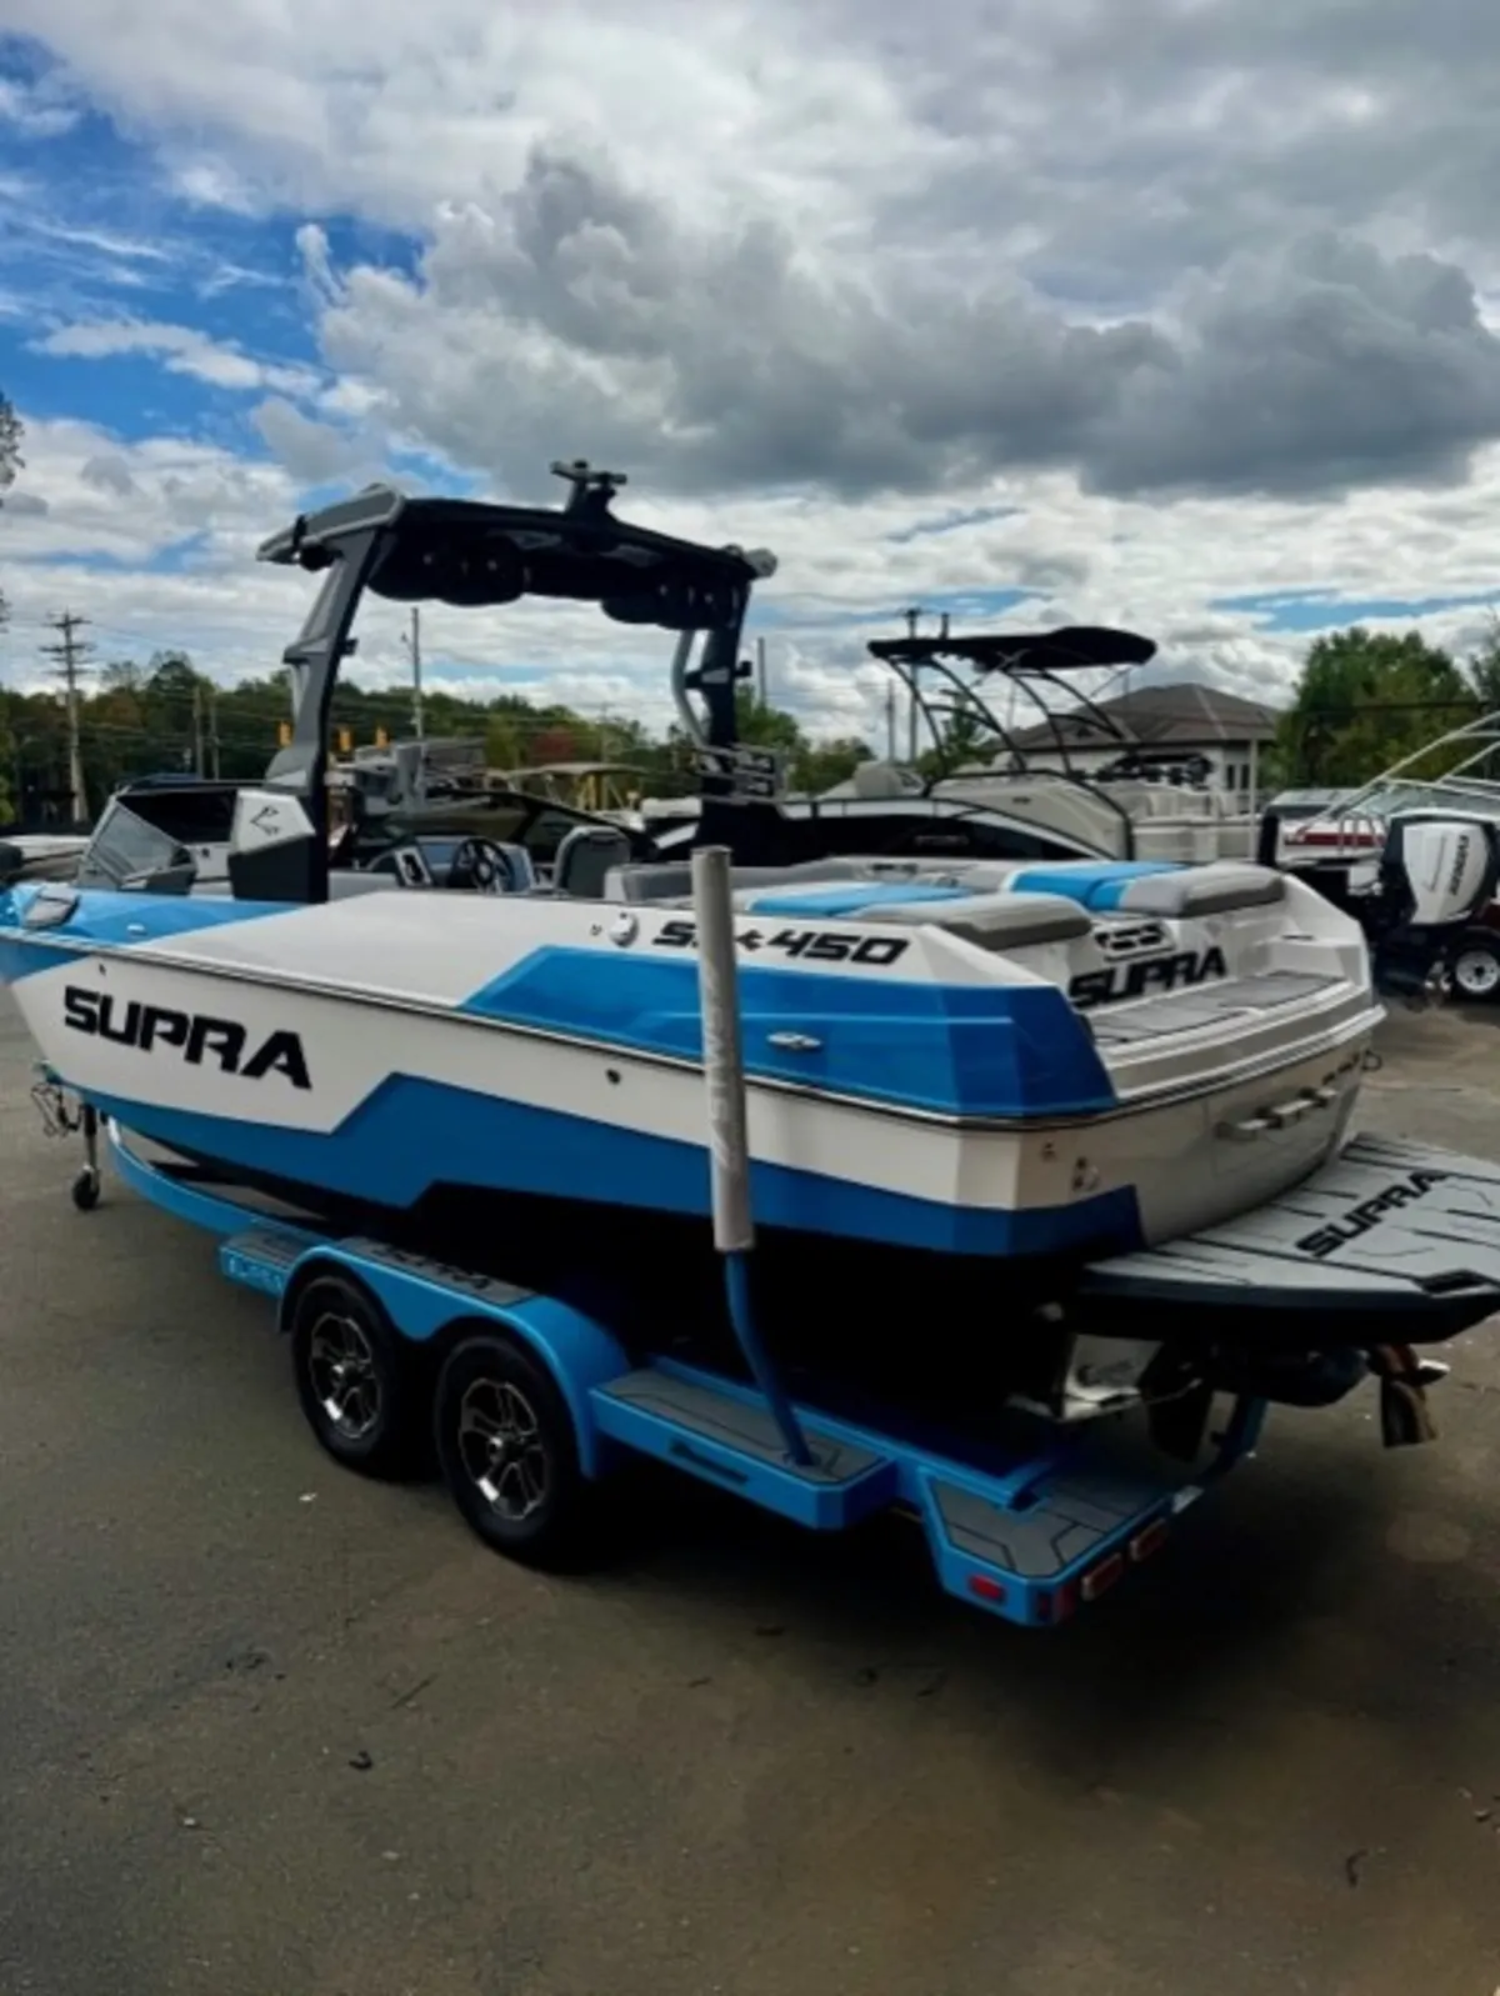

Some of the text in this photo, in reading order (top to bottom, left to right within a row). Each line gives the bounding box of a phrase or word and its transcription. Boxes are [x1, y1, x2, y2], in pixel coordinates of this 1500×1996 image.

[1067, 945, 1228, 1009] SUPRA
[64, 984, 313, 1091] SUPRA
[1295, 1169, 1449, 1259] SUPRA
